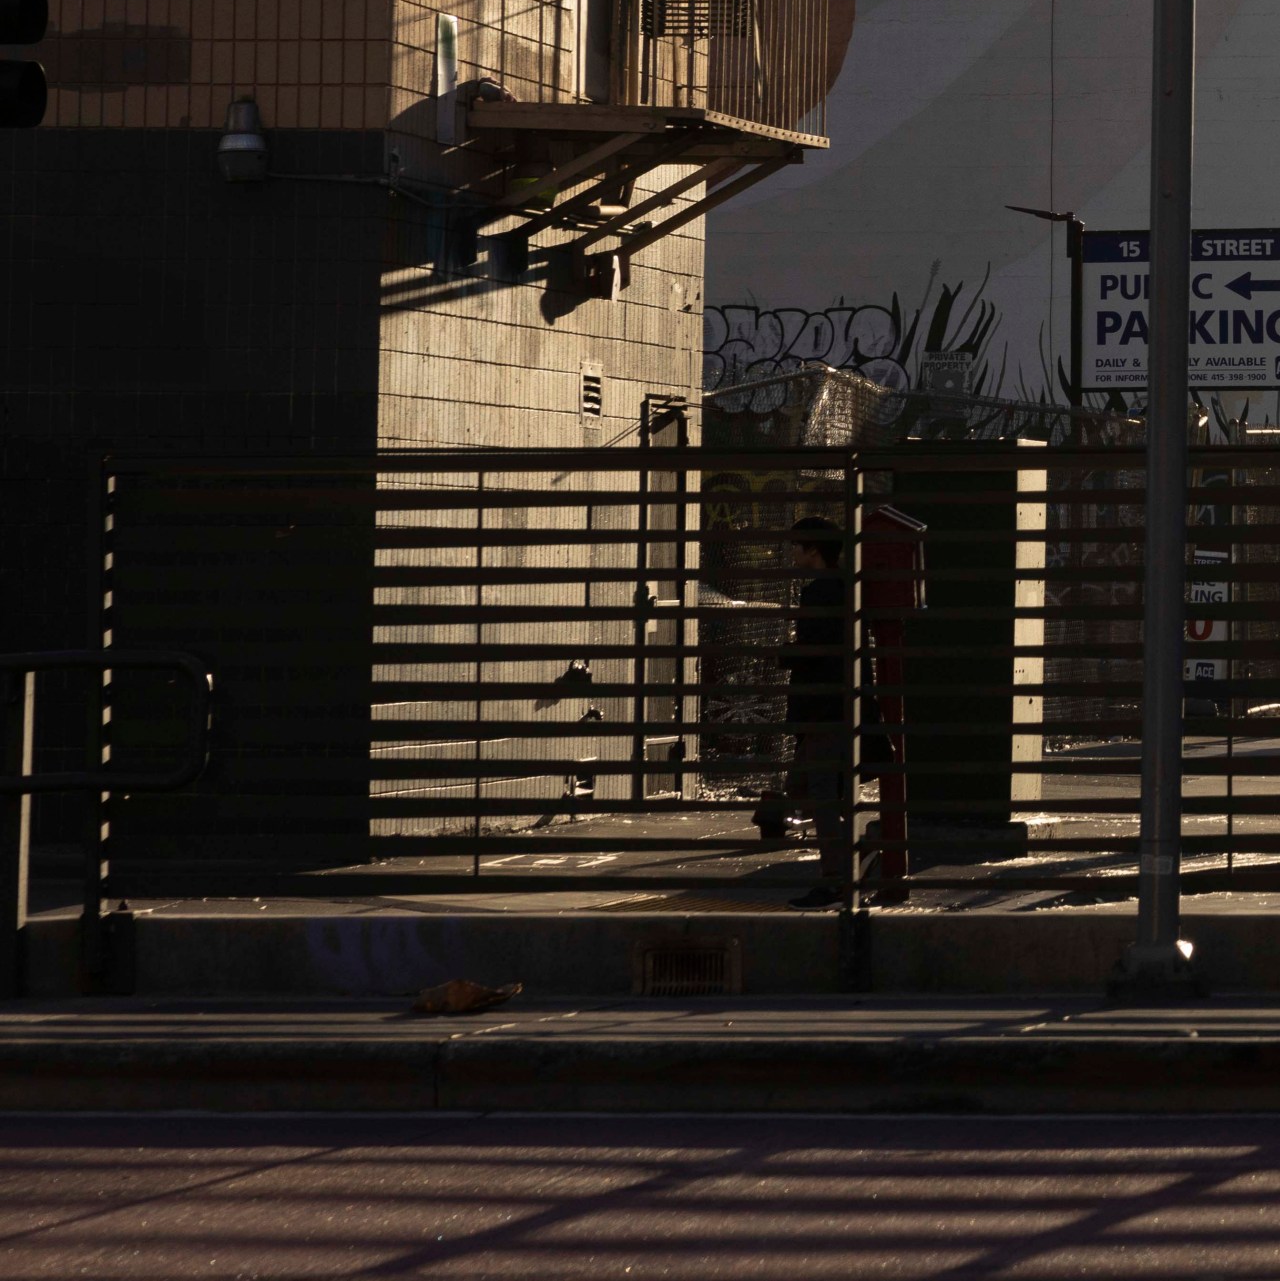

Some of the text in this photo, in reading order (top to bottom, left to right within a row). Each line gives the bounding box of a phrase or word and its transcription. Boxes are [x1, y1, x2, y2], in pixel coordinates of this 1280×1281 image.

[1119, 239, 1275, 257] 15 STREET
[1100, 273, 1213, 300] PUC
[924, 361, 971, 370] PROPERTY
[1095, 358, 1127, 368] DAILY
[1132, 358, 1141, 367] &
[1206, 357, 1267, 366] AVAILABLE
[1196, 666, 1214, 678] ACE
